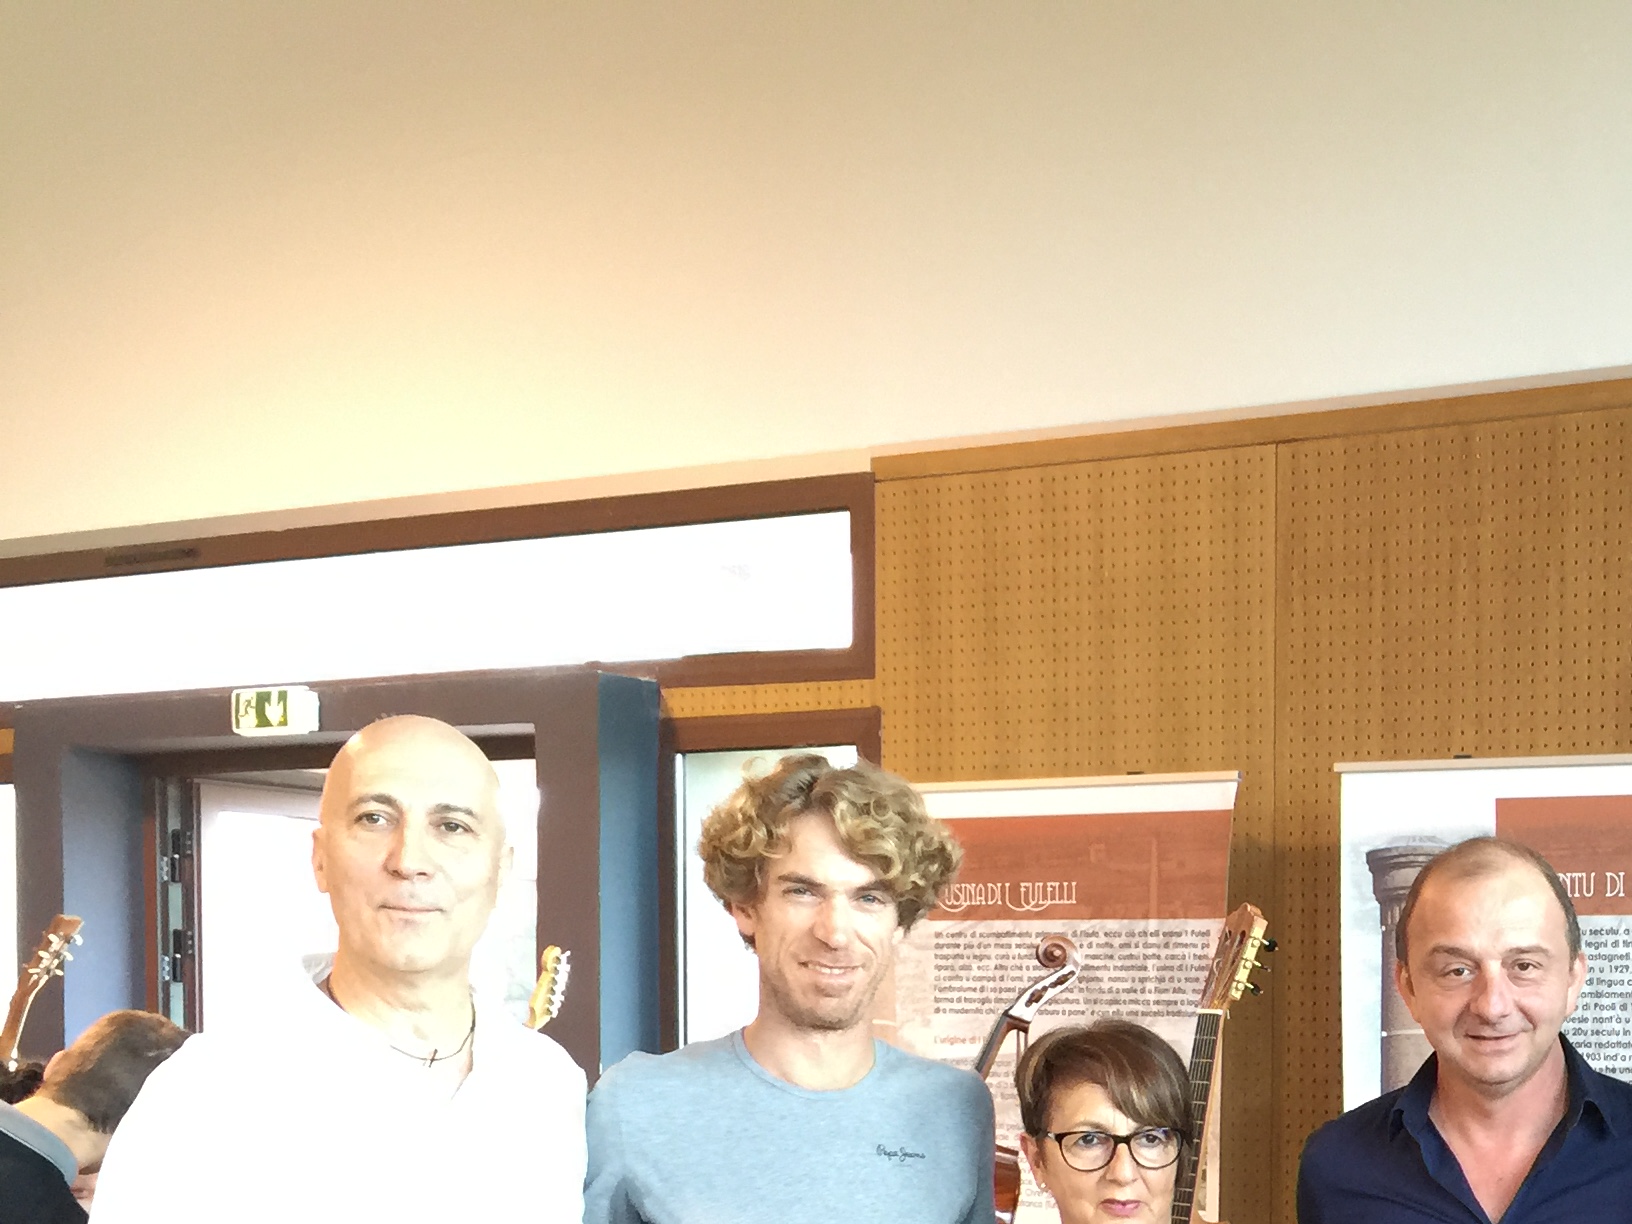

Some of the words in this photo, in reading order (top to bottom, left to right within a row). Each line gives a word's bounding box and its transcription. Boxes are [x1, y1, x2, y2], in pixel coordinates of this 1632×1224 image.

[1557, 872, 1595, 897] NTU
[1605, 871, 1625, 897] DI
[1611, 940, 1620, 948] di
[1585, 976, 1594, 986] di
[1596, 976, 1625, 988] lingua
[1593, 1002, 1616, 1011] Paoli
[1619, 1002, 1628, 1011] di
[1590, 1028, 1621, 1036] seculu
[1622, 1028, 1632, 1036] in
